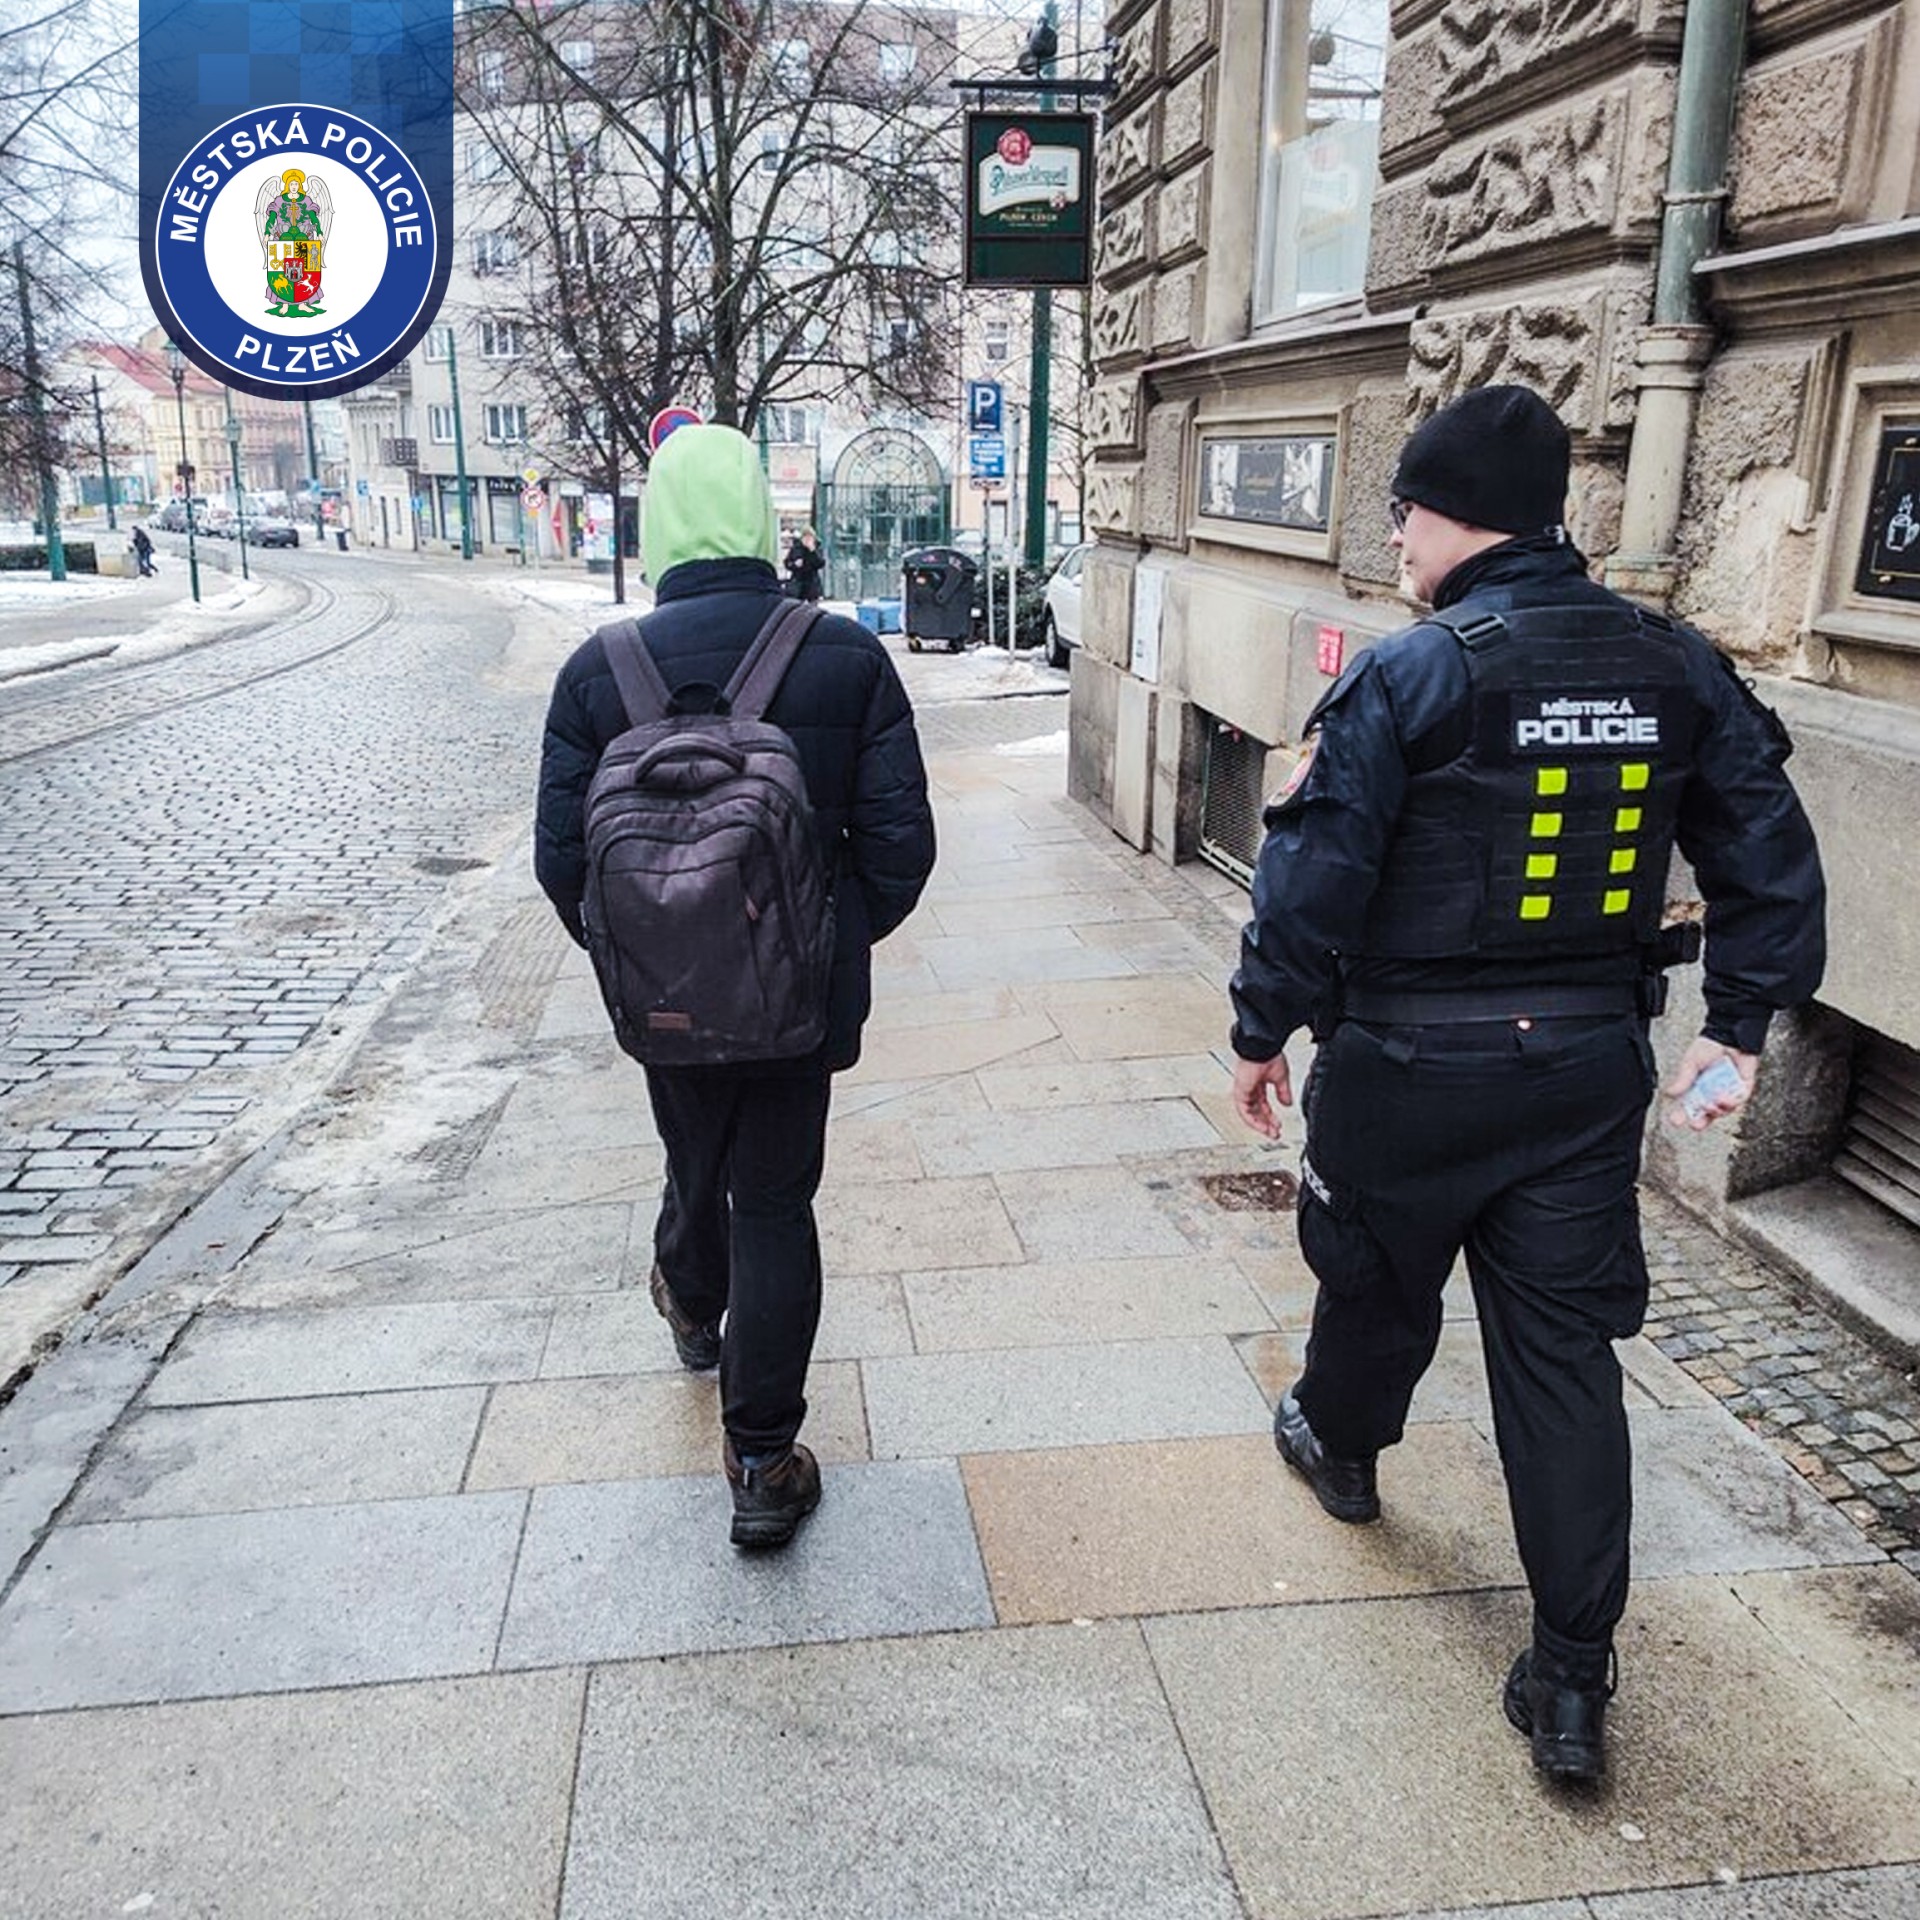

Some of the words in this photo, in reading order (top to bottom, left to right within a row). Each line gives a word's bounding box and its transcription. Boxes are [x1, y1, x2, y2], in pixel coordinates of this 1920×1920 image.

[975, 386, 997, 419] P
[1540, 697, 1635, 716] MĚSTSKÁ
[1517, 717, 1660, 746] POLICIE
